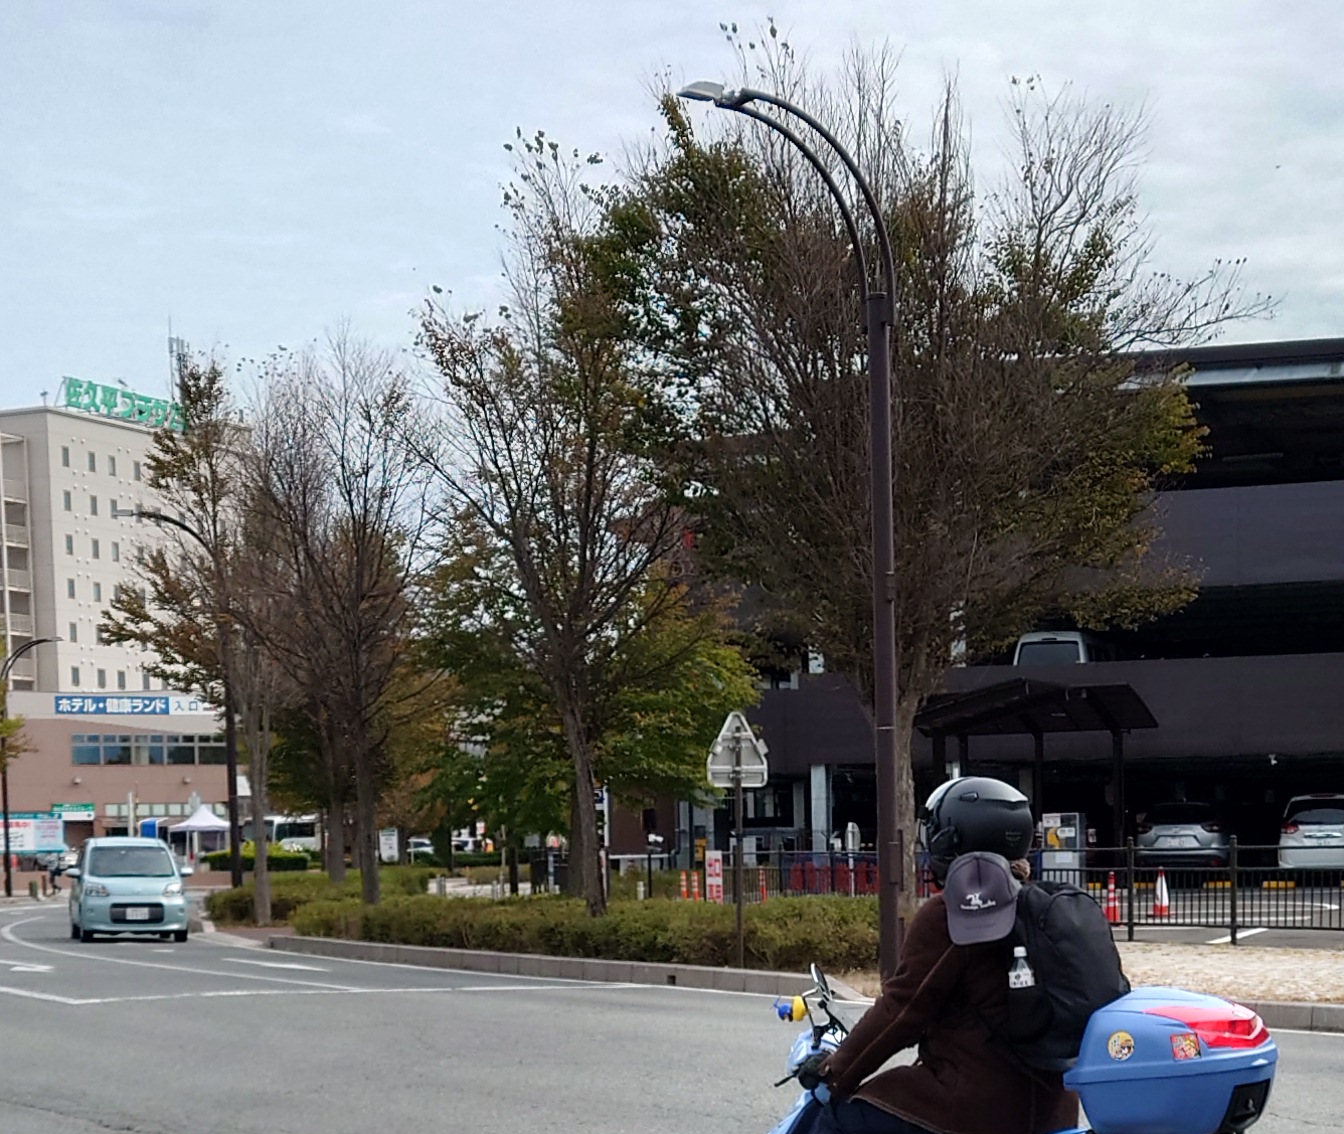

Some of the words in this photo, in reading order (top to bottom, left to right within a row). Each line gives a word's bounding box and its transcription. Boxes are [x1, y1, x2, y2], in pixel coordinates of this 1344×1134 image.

[58, 698, 166, 714] ホテル・健康ランド
[174, 701, 198, 712] 入口
